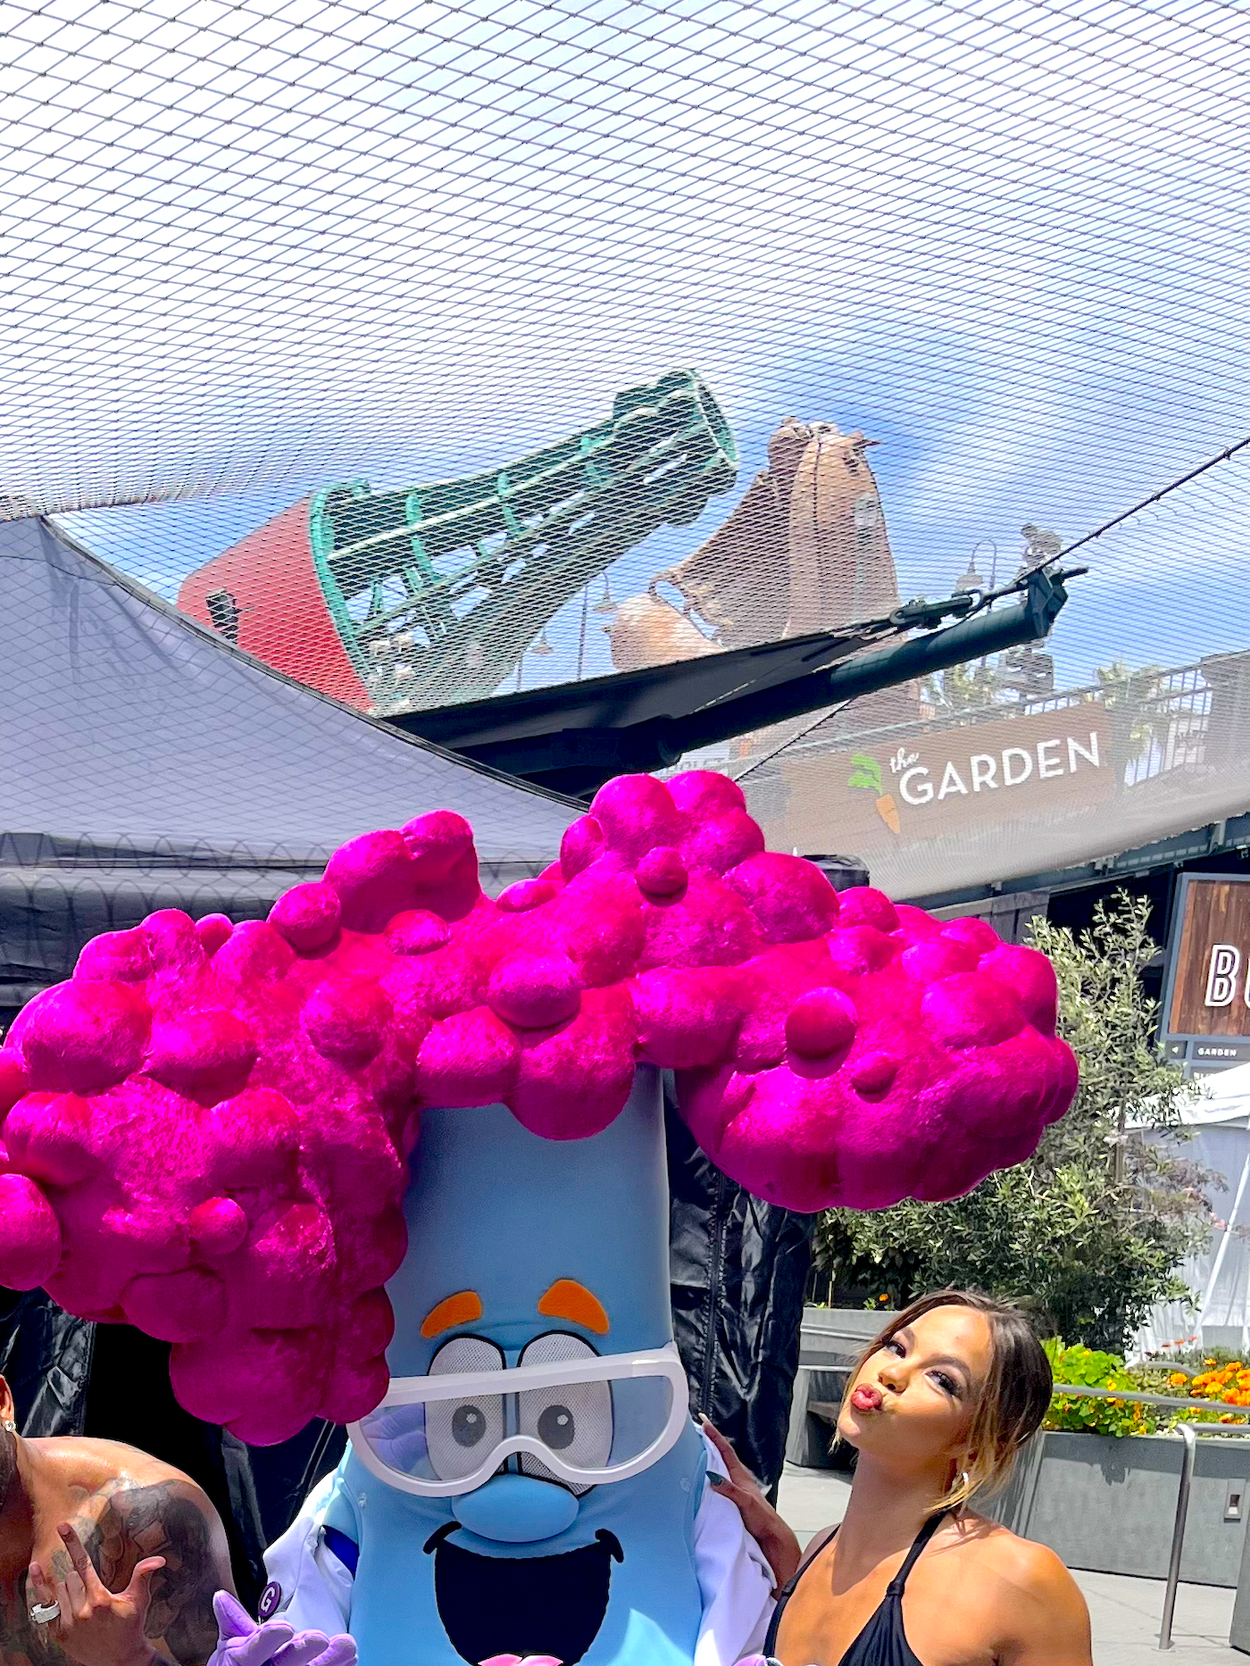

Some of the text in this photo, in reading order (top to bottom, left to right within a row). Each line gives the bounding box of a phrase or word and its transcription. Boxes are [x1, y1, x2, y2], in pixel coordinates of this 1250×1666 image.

[889, 747, 920, 774] the
[899, 731, 1100, 805] GARDEN
[1204, 943, 1250, 1009] B
[1197, 1047, 1238, 1057] GARDEN
[260, 1586, 276, 1613] G
